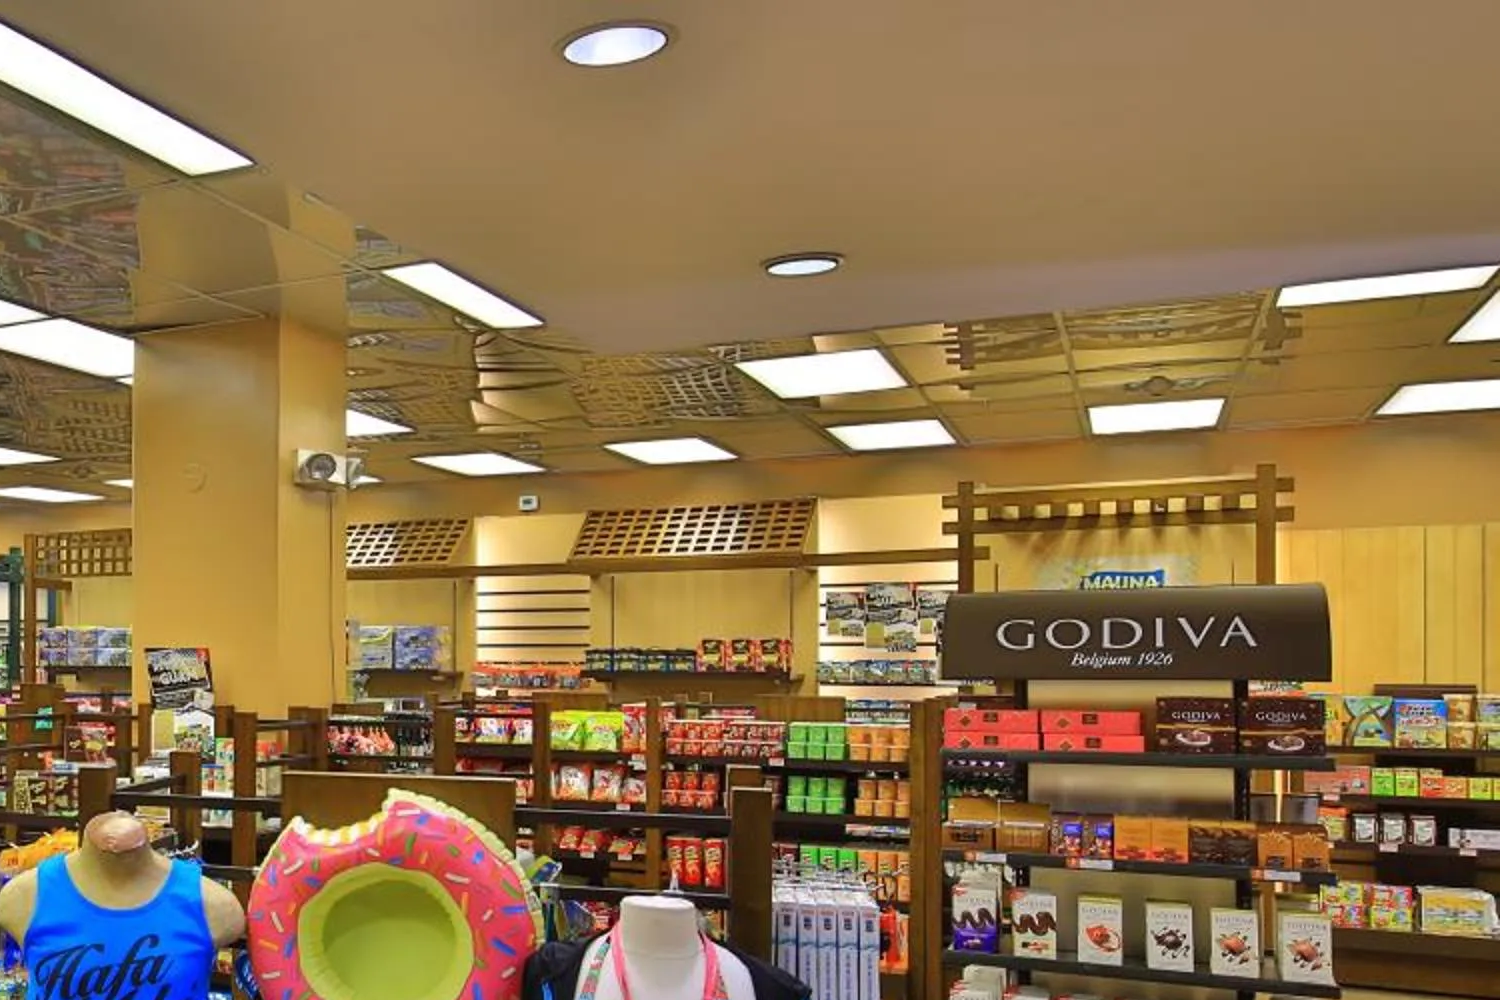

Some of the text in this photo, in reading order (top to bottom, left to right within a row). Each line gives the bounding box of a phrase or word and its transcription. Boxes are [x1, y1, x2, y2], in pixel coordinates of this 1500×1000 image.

[995, 615, 1259, 650] GODIVA
[1071, 652, 1174, 670] Belgium 1926
[1171, 711, 1221, 720] GODIVA
[1255, 712, 1307, 721] GODIVA
